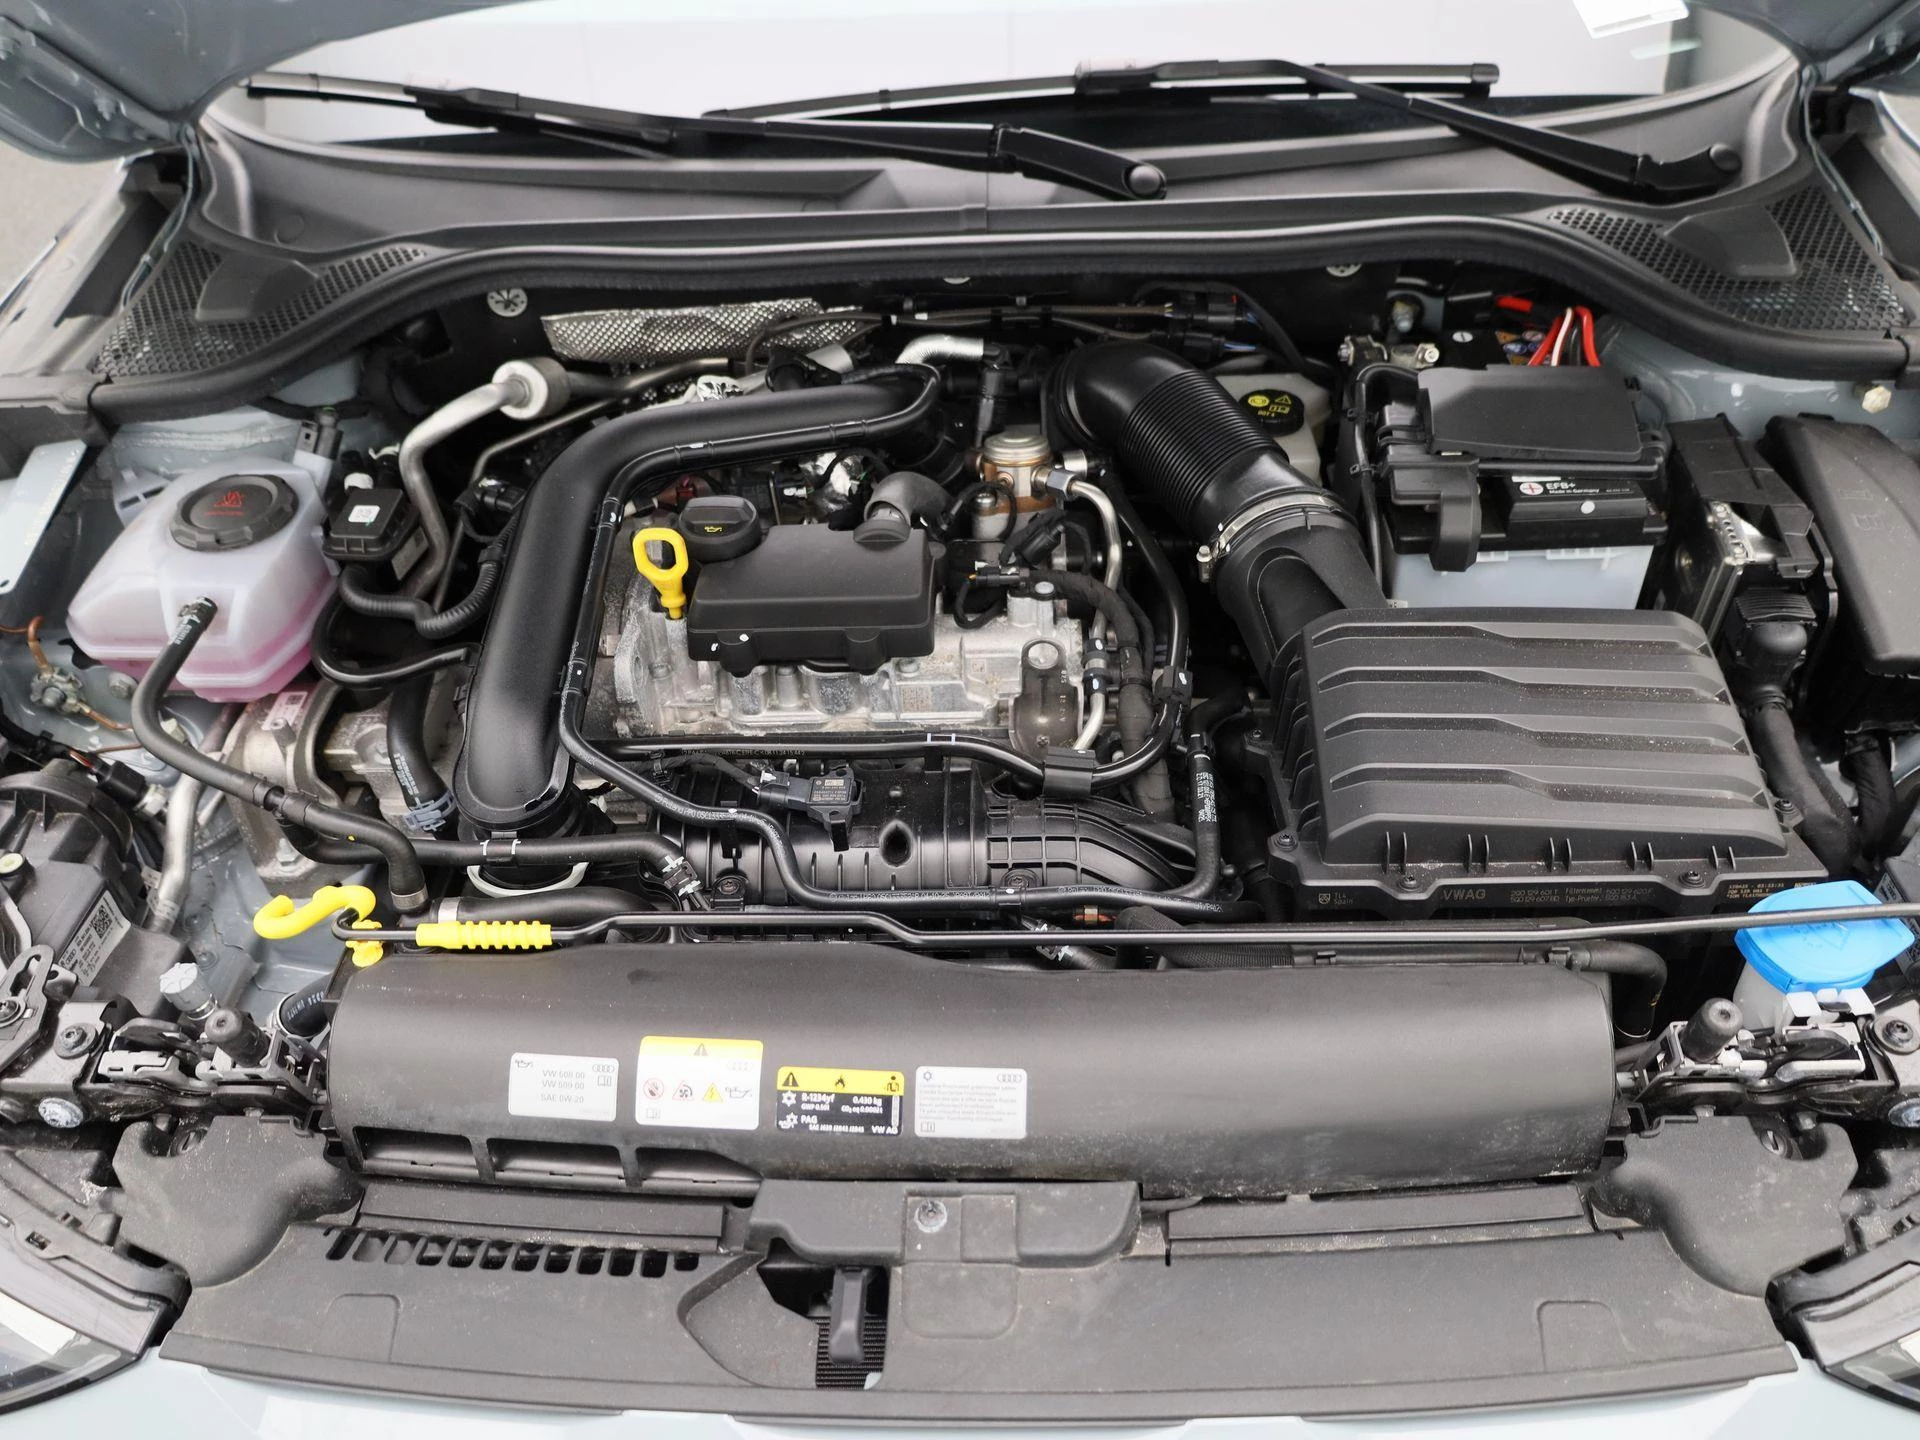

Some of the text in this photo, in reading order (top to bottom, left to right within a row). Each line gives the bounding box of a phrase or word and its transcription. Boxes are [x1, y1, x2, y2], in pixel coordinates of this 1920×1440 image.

[1546, 482, 1576, 490] EFB+
[542, 1069, 557, 1077] VW
[542, 1080, 557, 1088] VW
[801, 1092, 836, 1104] R-1234yf
[800, 1115, 818, 1124] PAG
[871, 1125, 885, 1134] VW
[886, 1125, 899, 1135] AG
